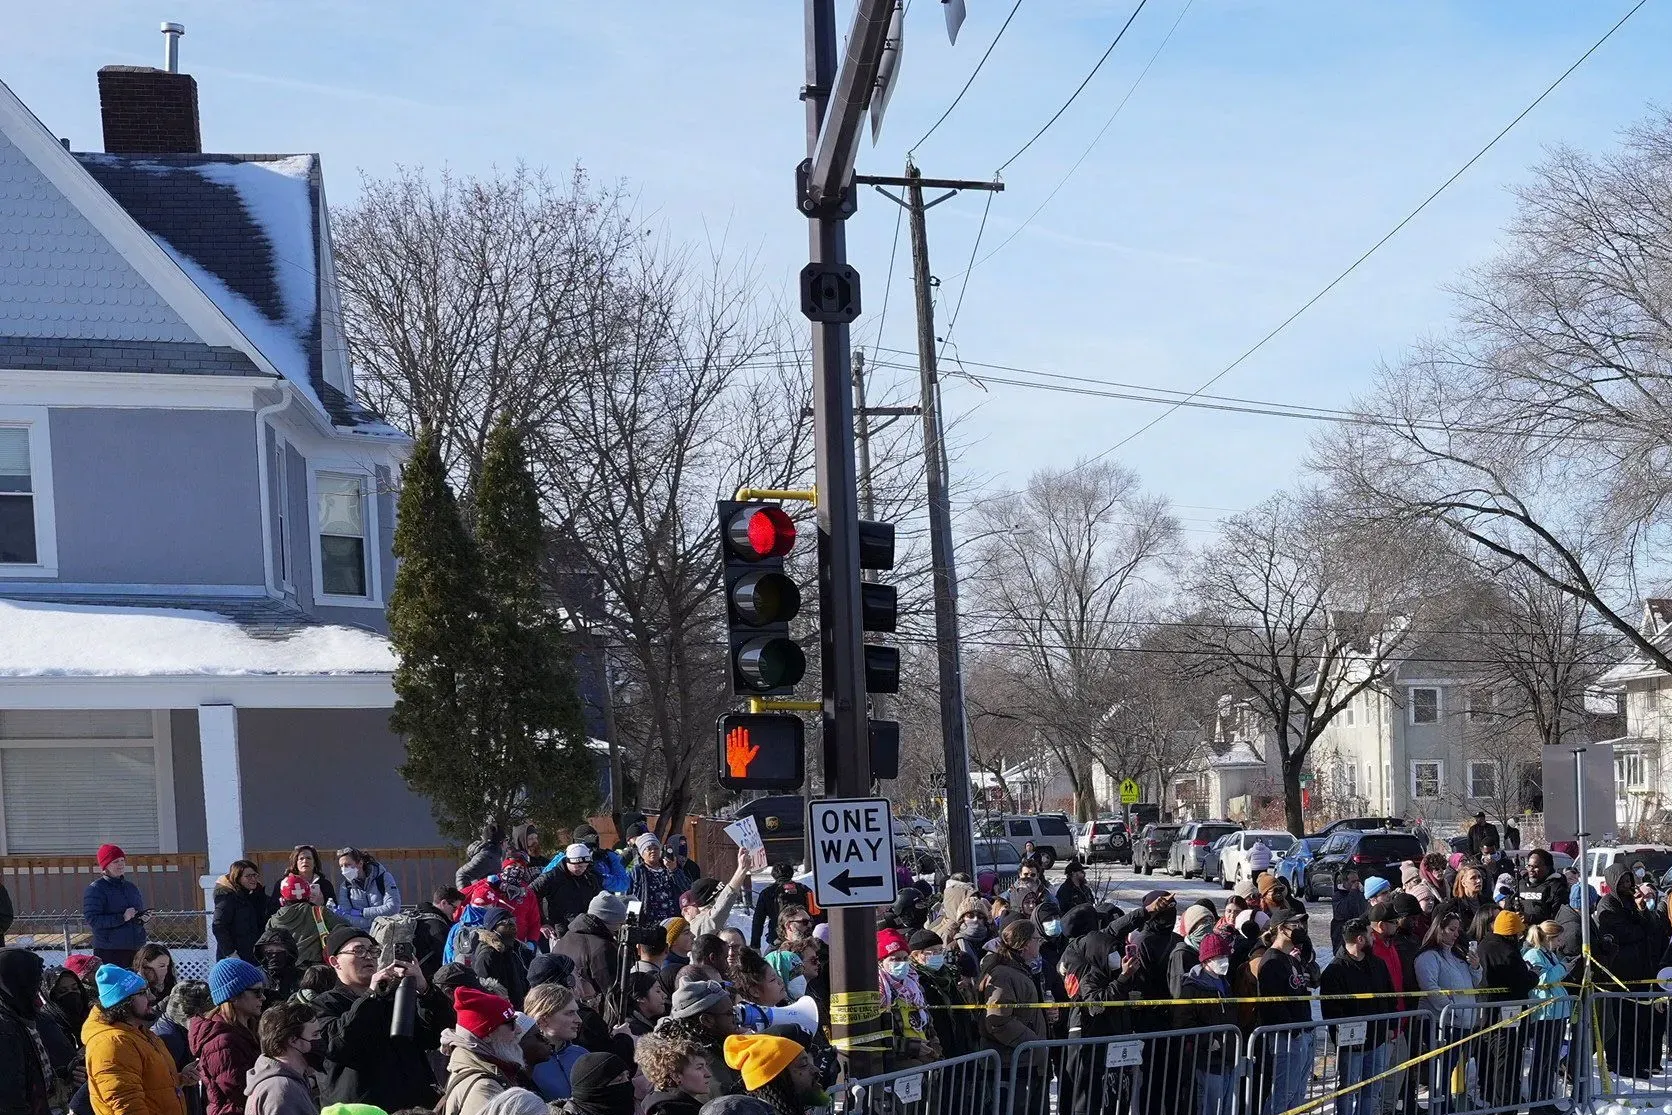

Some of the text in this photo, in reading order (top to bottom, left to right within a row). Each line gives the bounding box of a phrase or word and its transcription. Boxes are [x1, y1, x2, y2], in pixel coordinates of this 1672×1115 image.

[821, 808, 881, 834] ONE
[820, 838, 883, 864] WAY
[1519, 892, 1542, 901] RESS
